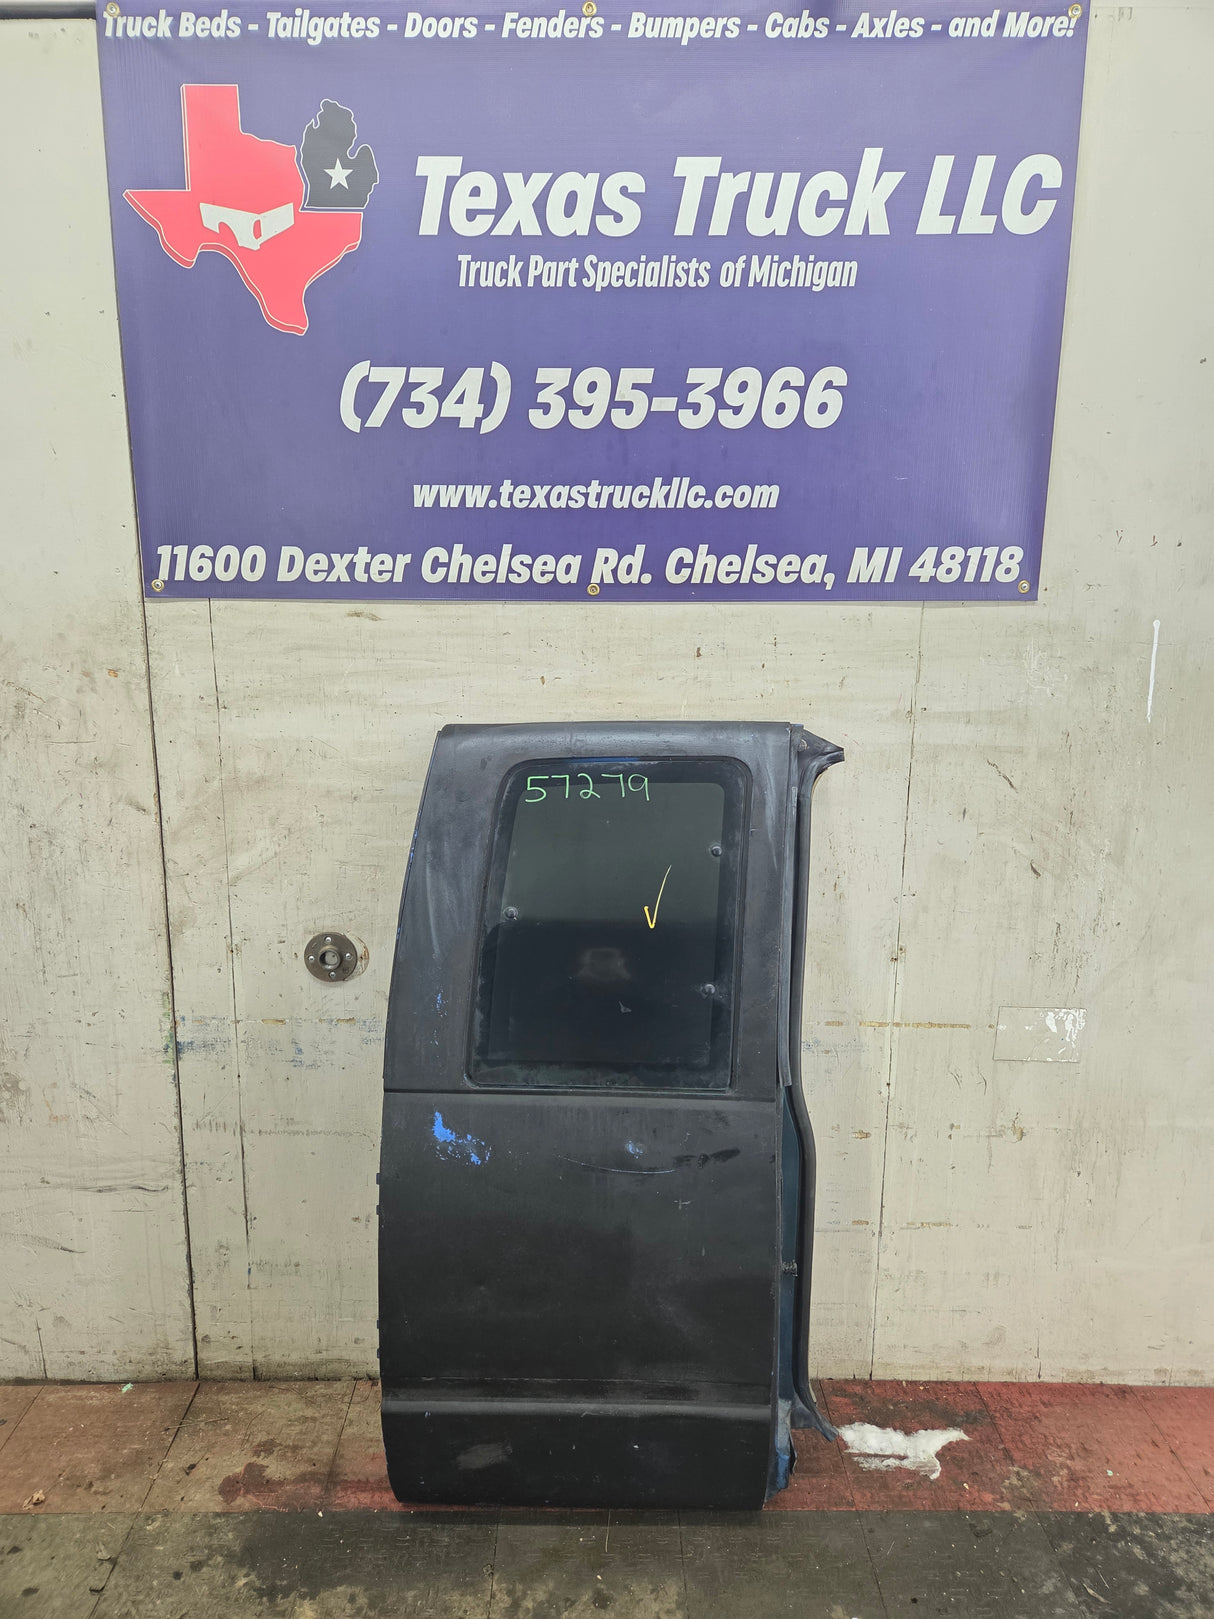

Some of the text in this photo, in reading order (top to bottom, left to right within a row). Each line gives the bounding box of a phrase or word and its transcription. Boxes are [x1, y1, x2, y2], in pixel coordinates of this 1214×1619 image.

[102, 11, 173, 38] Truck
[177, 10, 242, 38] Beds
[266, 9, 381, 45] Tailgates
[404, 12, 479, 38] Doors
[501, 11, 605, 38] Fenders
[627, 12, 741, 45] Bumpers
[765, 10, 829, 38] Cabs
[851, 10, 925, 38] Axles
[948, 10, 1000, 38] and
[1002, 12, 1077, 38] More!
[416, 147, 1063, 237] Texas Truck LLC
[457, 255, 858, 292] Truck Part Specialists of Michigan
[339, 360, 848, 434] (734) 395-3966
[413, 477, 780, 509] www.texastruckllc.com
[156, 544, 1024, 591] 11600 Dexter Chelsea Rd. Chelsea, MI 48118
[525, 773, 650, 803] 57279
